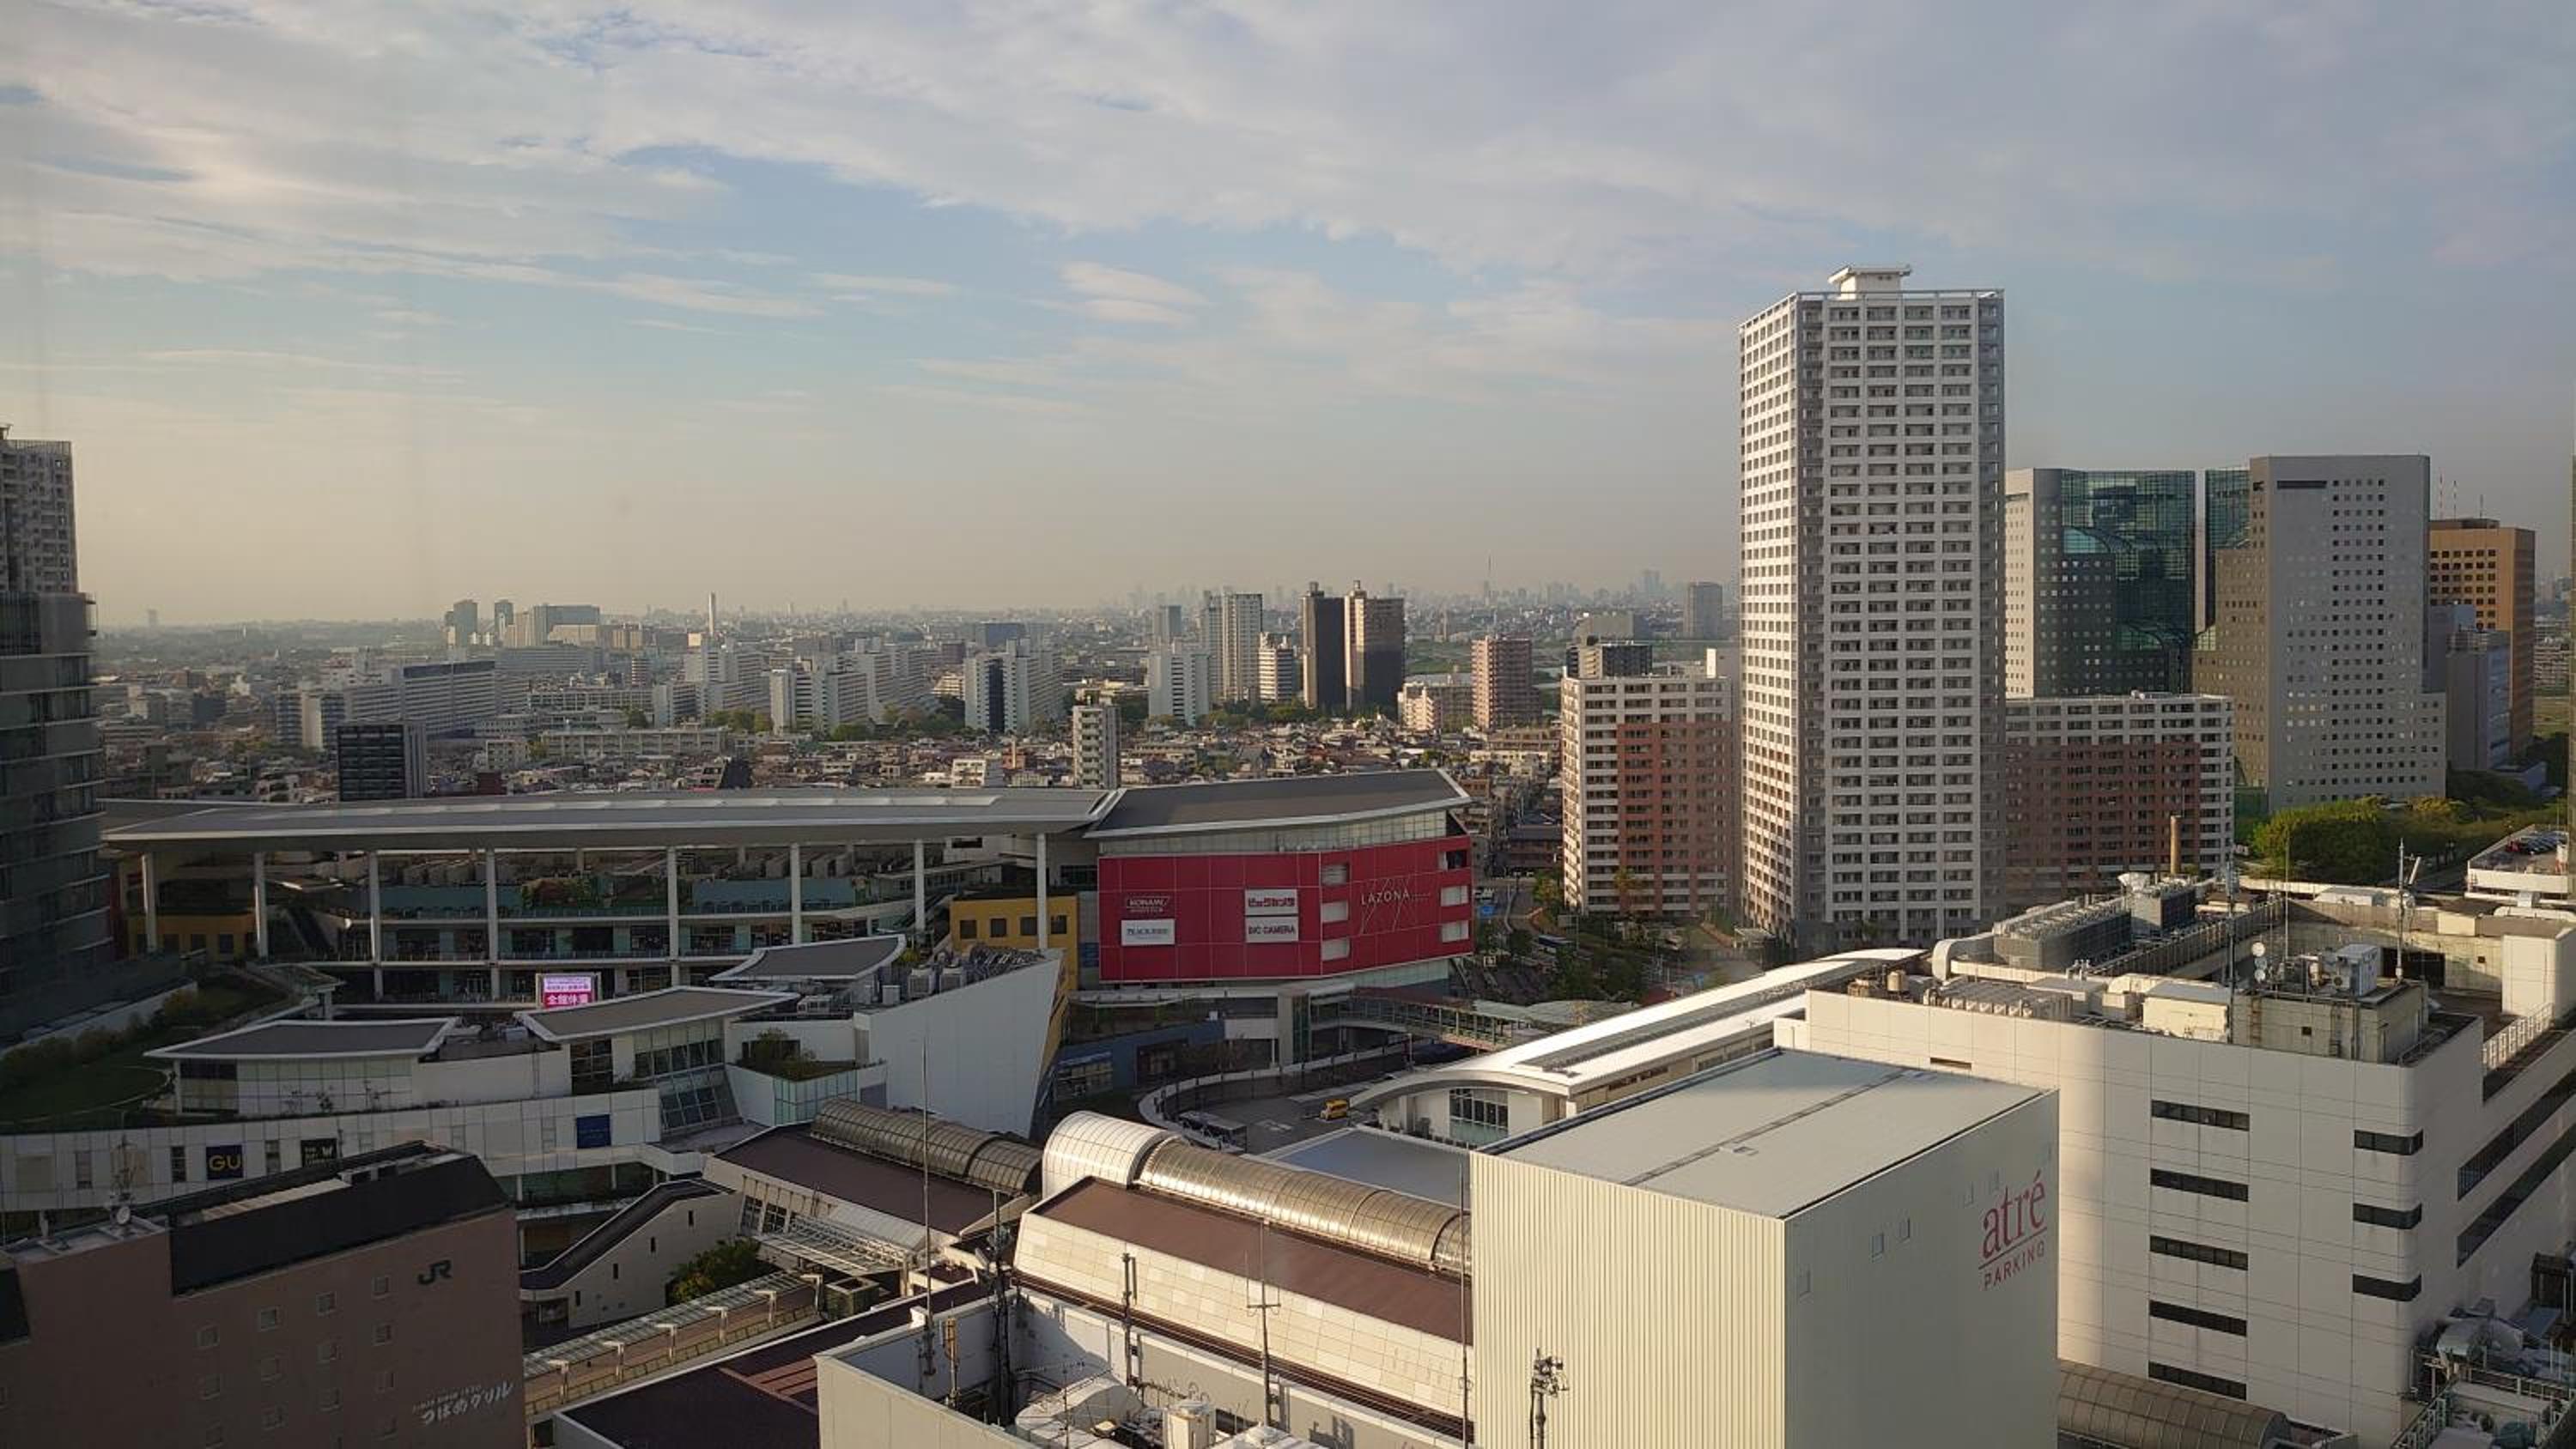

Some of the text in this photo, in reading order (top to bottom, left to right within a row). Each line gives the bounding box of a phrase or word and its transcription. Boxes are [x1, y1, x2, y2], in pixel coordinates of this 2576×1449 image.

[1361, 888, 1410, 906] LAZONA
[1263, 925, 1296, 935] CAMERA
[209, 1154, 241, 1171] GU
[1982, 1168, 2046, 1258] atré
[417, 1258, 453, 1285] JR
[1984, 1240, 2045, 1288] PARKING
[421, 1380, 514, 1426] つばめグリル
